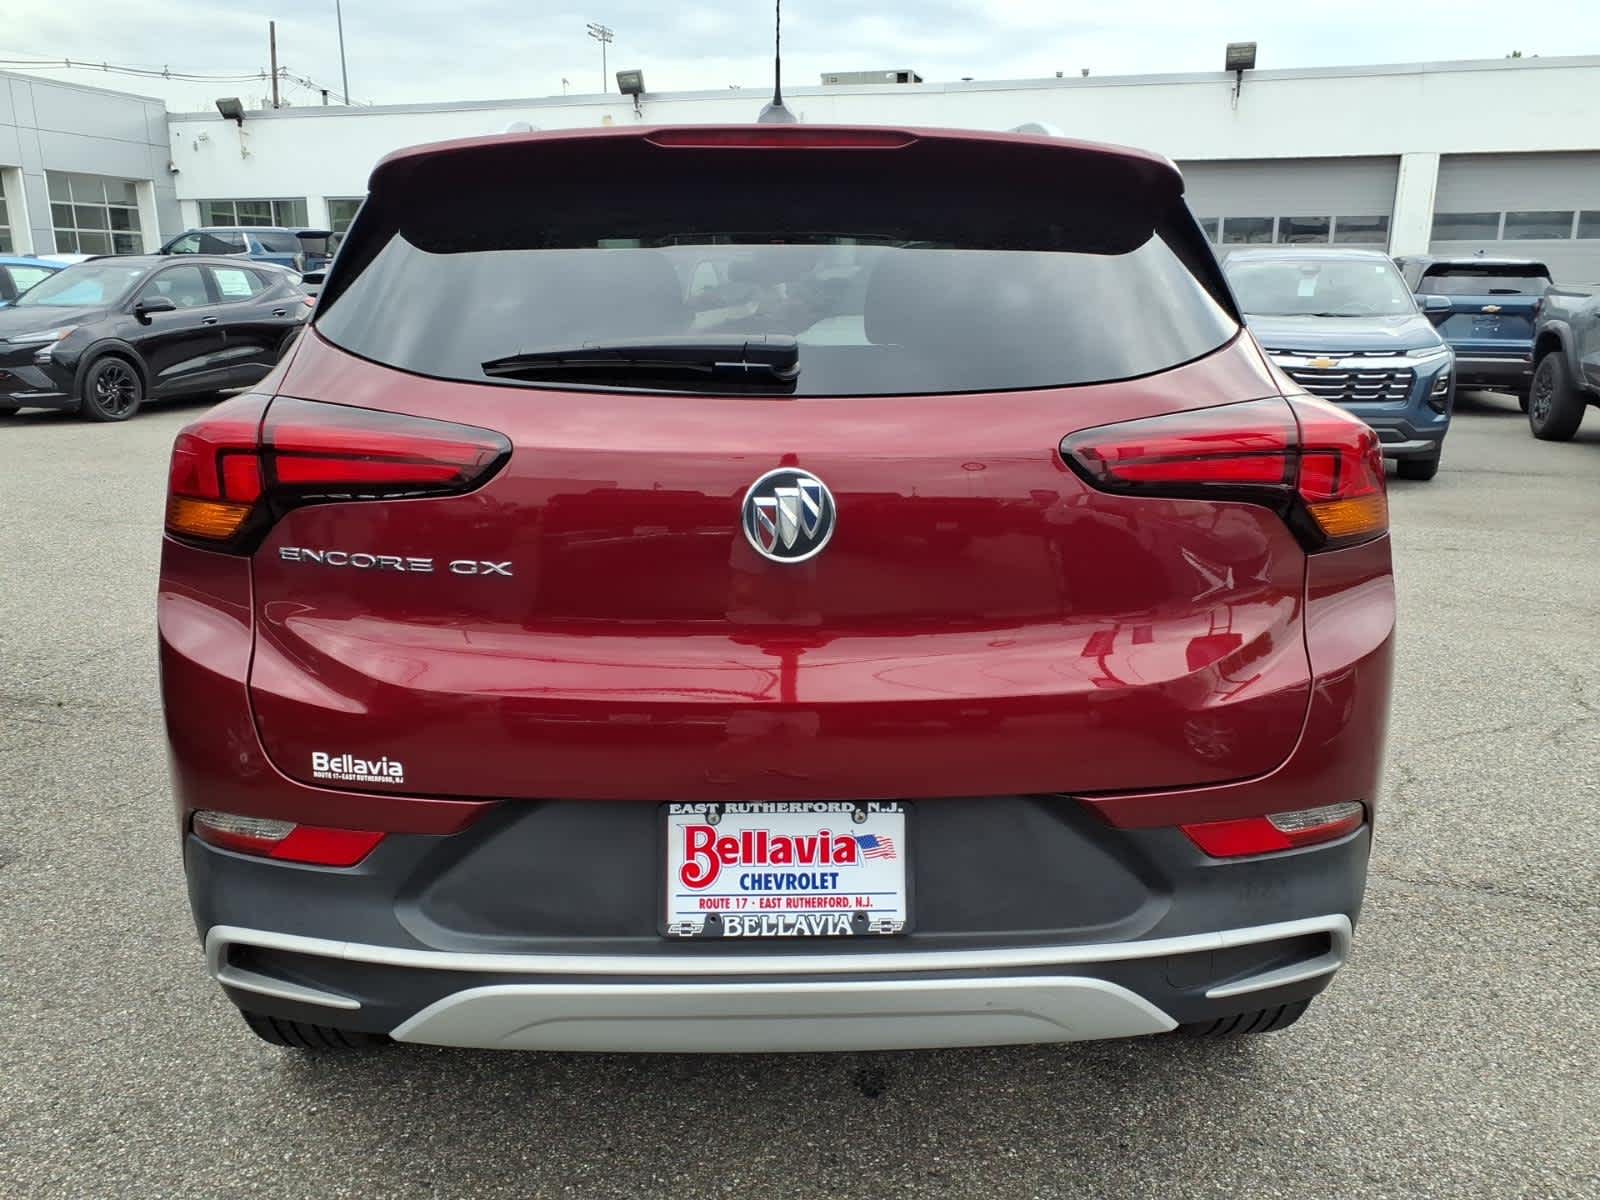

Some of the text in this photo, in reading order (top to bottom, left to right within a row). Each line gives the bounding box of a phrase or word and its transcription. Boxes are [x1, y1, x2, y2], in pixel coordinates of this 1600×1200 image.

[279, 546, 513, 576] ENCORE GX
[312, 752, 403, 776] Bellavia
[669, 802, 904, 814] EAST RUTHERFORD, N.J.
[679, 824, 858, 891] Bellavia
[739, 872, 839, 891] CHEVROLET
[699, 897, 873, 909] ROUTE 17 EAST RUTHERFORD, N.J.
[722, 914, 854, 937] BELLAVIA
